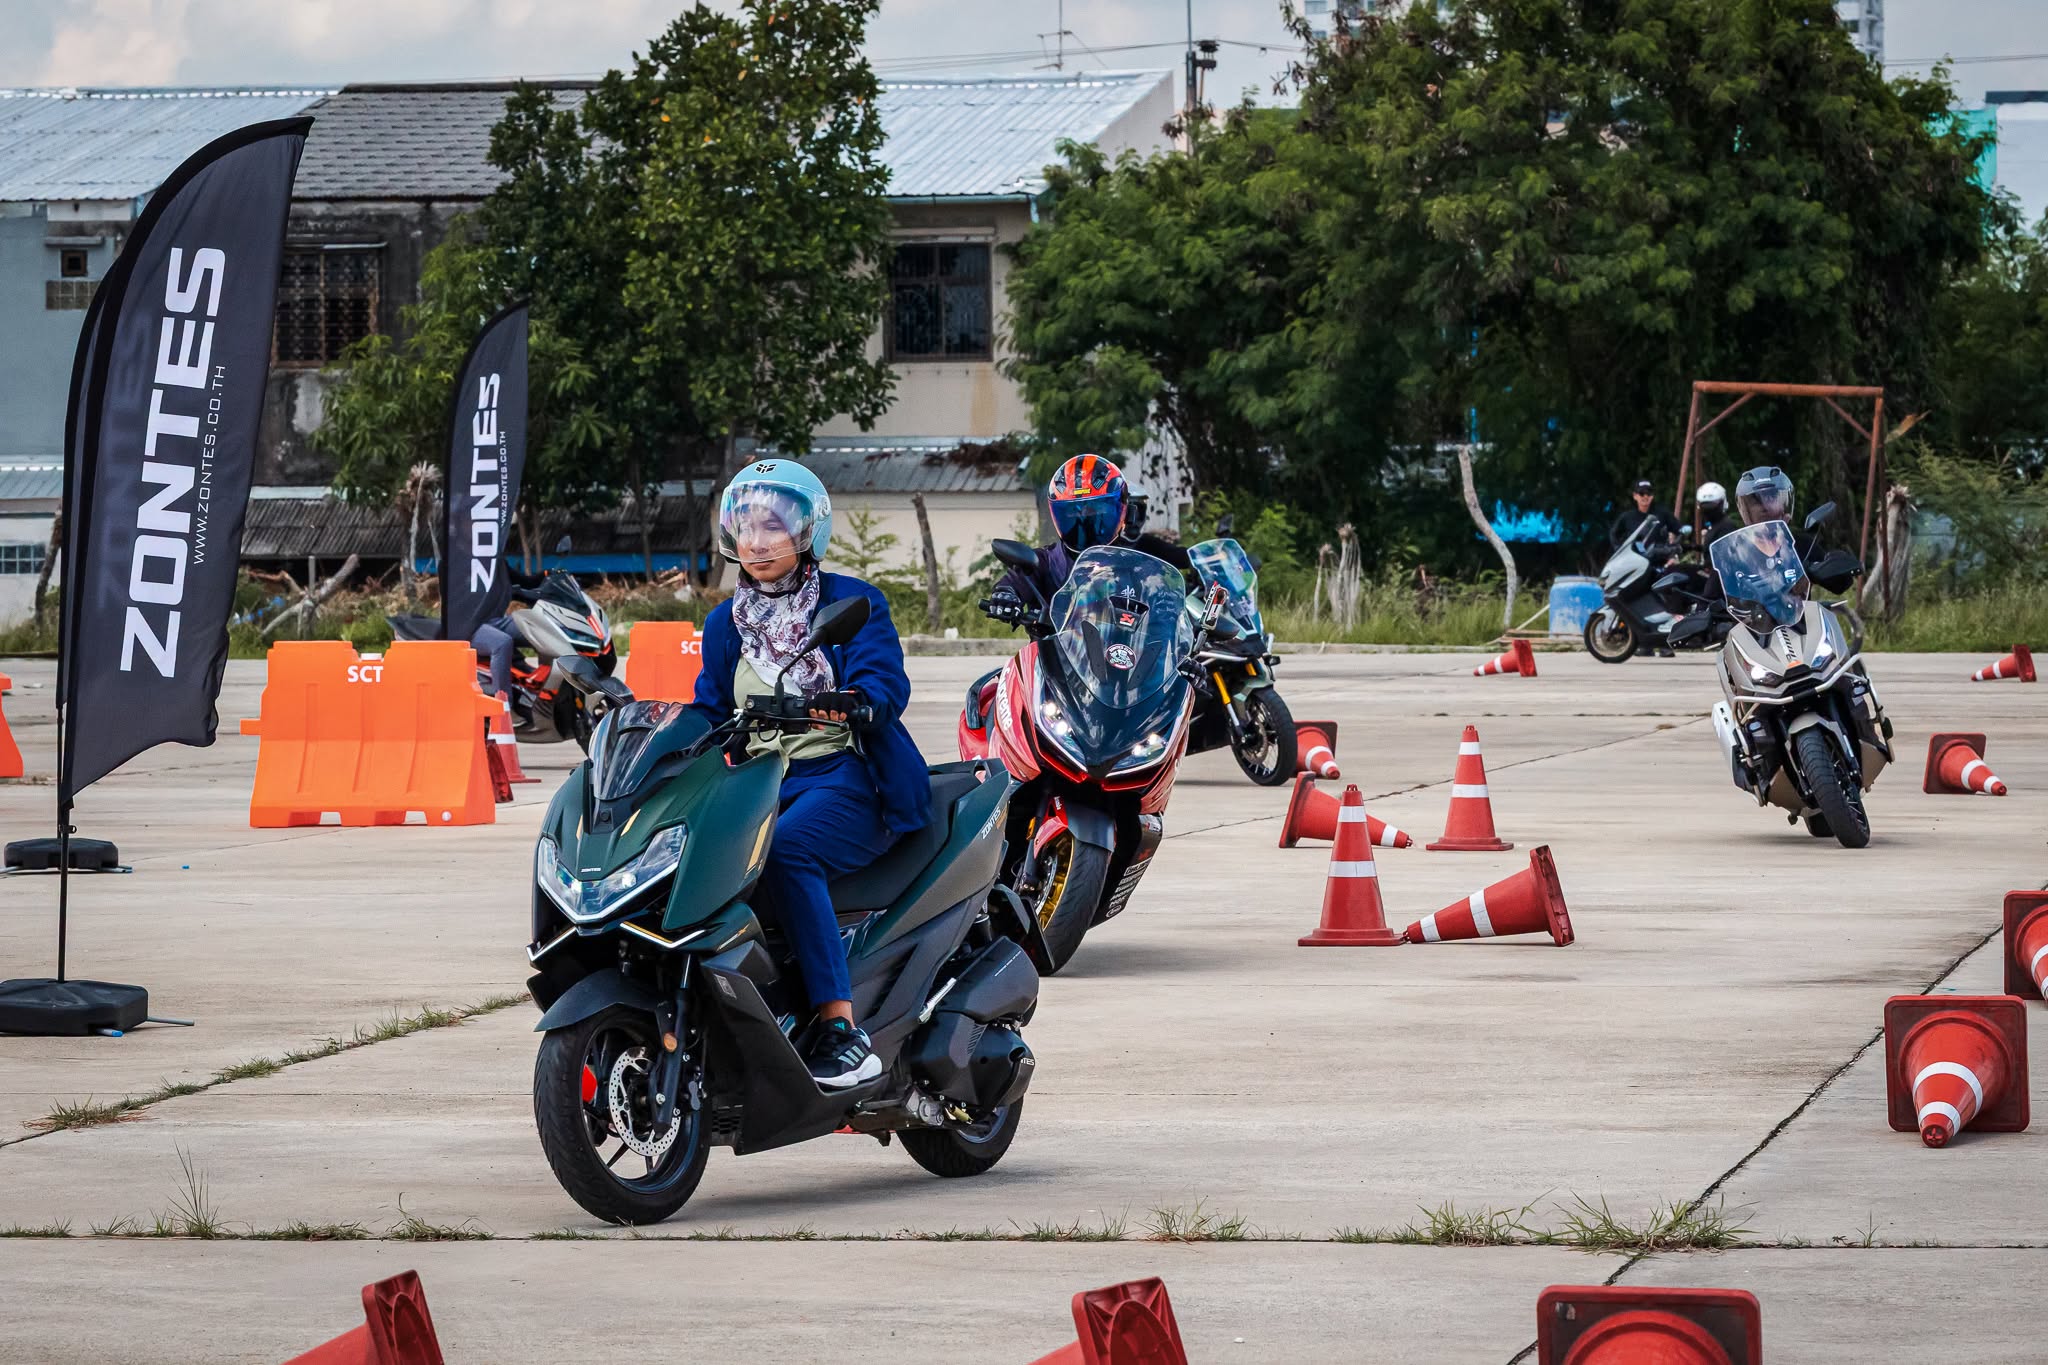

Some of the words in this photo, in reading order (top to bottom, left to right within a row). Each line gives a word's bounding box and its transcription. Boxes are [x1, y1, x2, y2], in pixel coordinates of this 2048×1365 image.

[120, 247, 226, 678] ZONTES
[193, 365, 226, 564] WWW.ZONTES.CO.TH
[469, 373, 500, 593] ZONTES
[347, 665, 384, 683] SCT
[995, 666, 1013, 731] Supreme
[981, 807, 1001, 840] ZONTES
